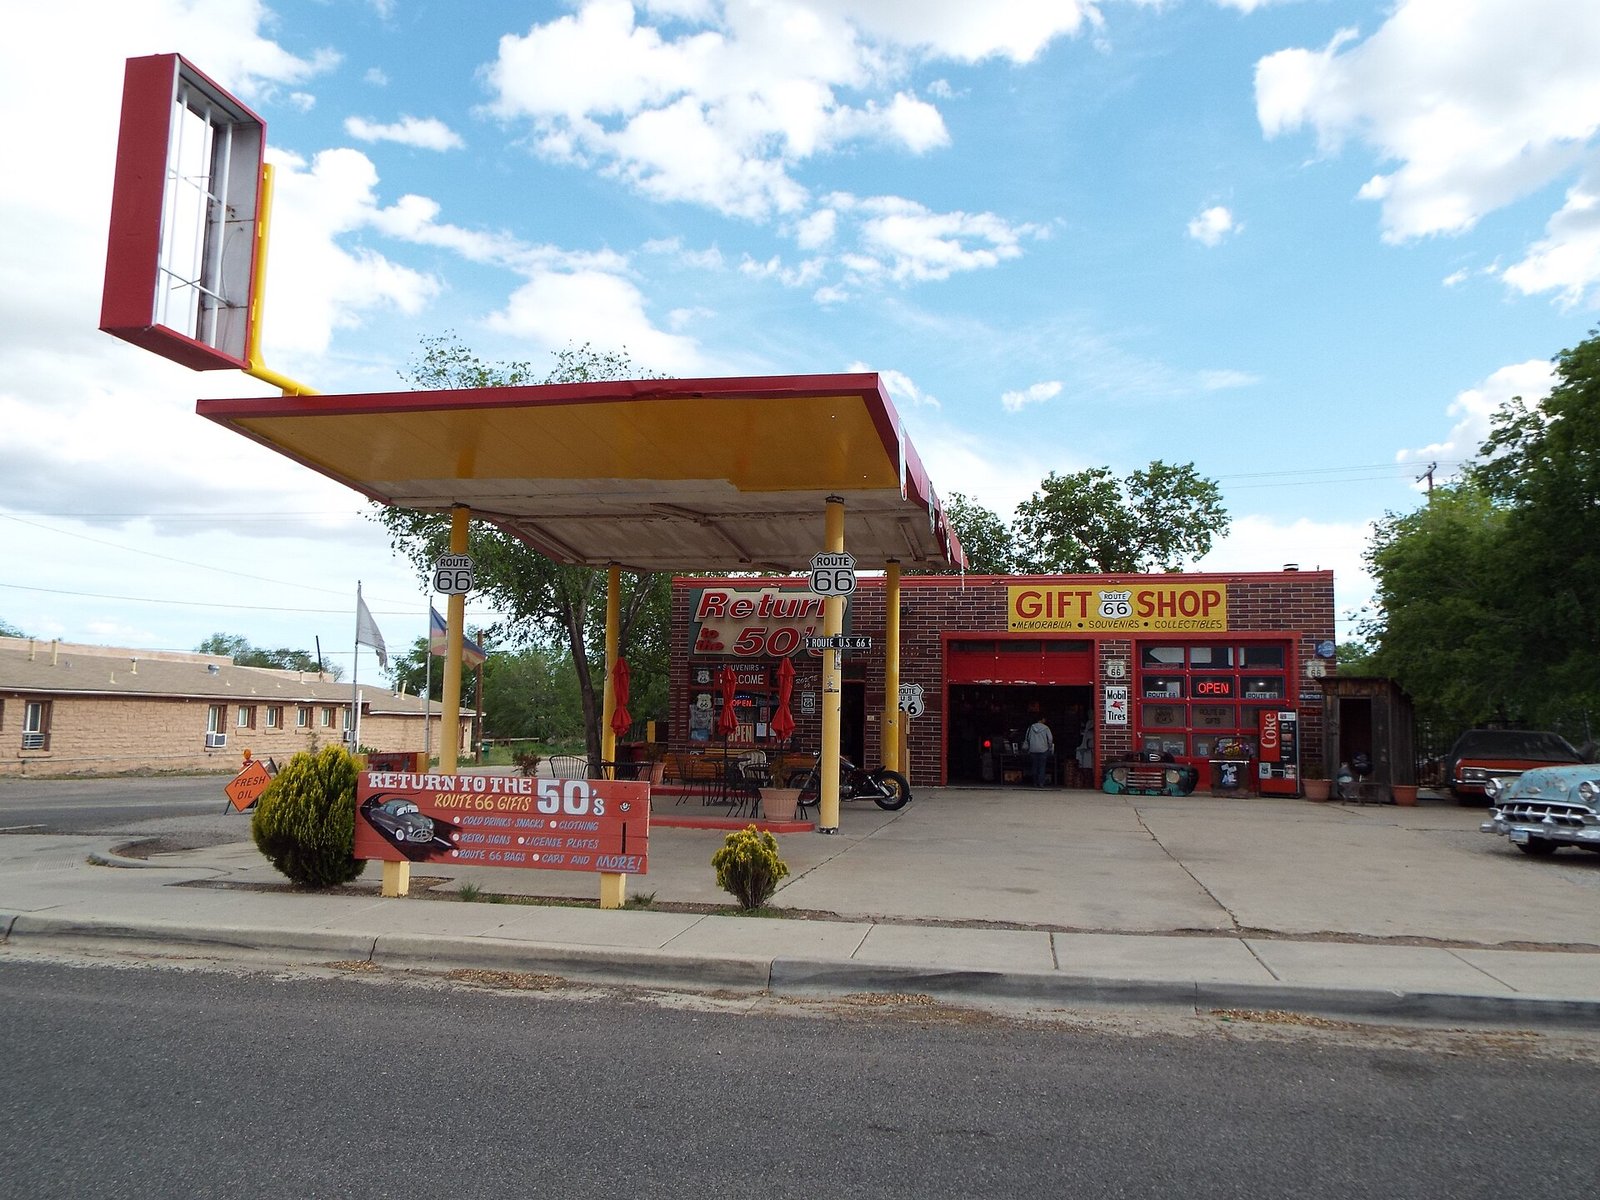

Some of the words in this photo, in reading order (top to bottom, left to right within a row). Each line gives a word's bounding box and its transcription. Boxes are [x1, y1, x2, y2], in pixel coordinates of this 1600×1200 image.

[440, 558, 469, 567] ROUTE
[817, 557, 849, 566] ROUTE
[437, 570, 470, 590] 66
[814, 570, 853, 591] 66
[1015, 591, 1093, 619] GIFT
[1136, 590, 1222, 618] SHOP
[1103, 603, 1128, 615] 66
[1016, 620, 1072, 629] MEMORABILIA
[1088, 620, 1140, 629] SOUVENIRS
[1154, 619, 1223, 629] COLLECTIBLES
[701, 627, 719, 639] to
[732, 626, 824, 656] 50'
[811, 638, 834, 648] ROUTE
[856, 638, 866, 647] 66
[722, 664, 760, 672] SUVENIRS
[1111, 668, 1121, 676] 66
[1311, 669, 1321, 677] 66
[1198, 682, 1229, 694] OPEN
[1107, 690, 1127, 699] Mobil
[731, 699, 752, 707] OPEN
[1108, 711, 1126, 720] Tires
[1261, 713, 1277, 748] Coke
[234, 776, 266, 787] FRESH
[237, 790, 253, 800] OIL
[368, 772, 457, 791] RETURN
[461, 776, 486, 793] TO
[490, 778, 532, 794] THE
[537, 779, 605, 816] 50's
[434, 793, 473, 808] ROUTE
[475, 795, 494, 811] 66
[497, 796, 532, 812] GIFTS
[462, 816, 482, 826] COLD
[483, 816, 512, 828] DRINKS
[514, 819, 545, 829] SNACKS
[558, 820, 599, 831] CLOTHING
[461, 833, 485, 843] RETRO
[486, 834, 511, 845] SIGNS
[525, 836, 562, 847] LICENSE
[566, 838, 599, 849] PLATES
[459, 849, 486, 859] ROUTE
[488, 851, 502, 861] 66
[503, 851, 526, 862] BAGS
[541, 854, 565, 863] CAPS
[570, 855, 590, 865] AND
[595, 855, 643, 871] MORE!
